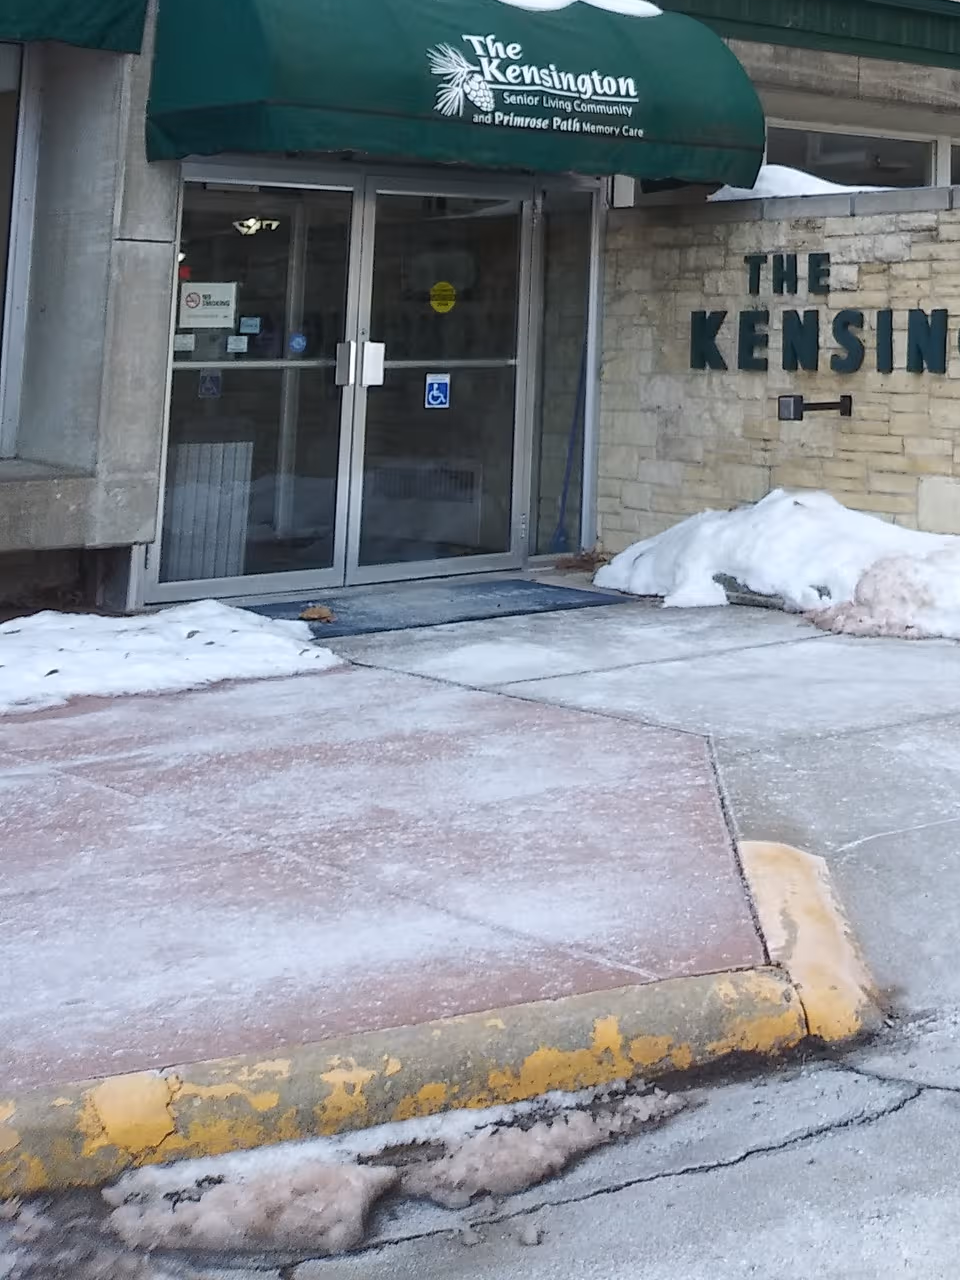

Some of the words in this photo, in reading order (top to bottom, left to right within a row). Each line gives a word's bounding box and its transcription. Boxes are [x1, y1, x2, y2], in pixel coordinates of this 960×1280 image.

[461, 34, 523, 60] The
[478, 56, 638, 99] Kensington
[502, 91, 540, 106] Senior
[542, 95, 572, 113] Living
[573, 100, 633, 117] Community
[472, 112, 491, 125] and
[494, 112, 549, 130] Primrose
[552, 117, 580, 133] Path
[582, 122, 620, 137] Memory
[622, 125, 644, 138] Care
[744, 252, 831, 296] THE
